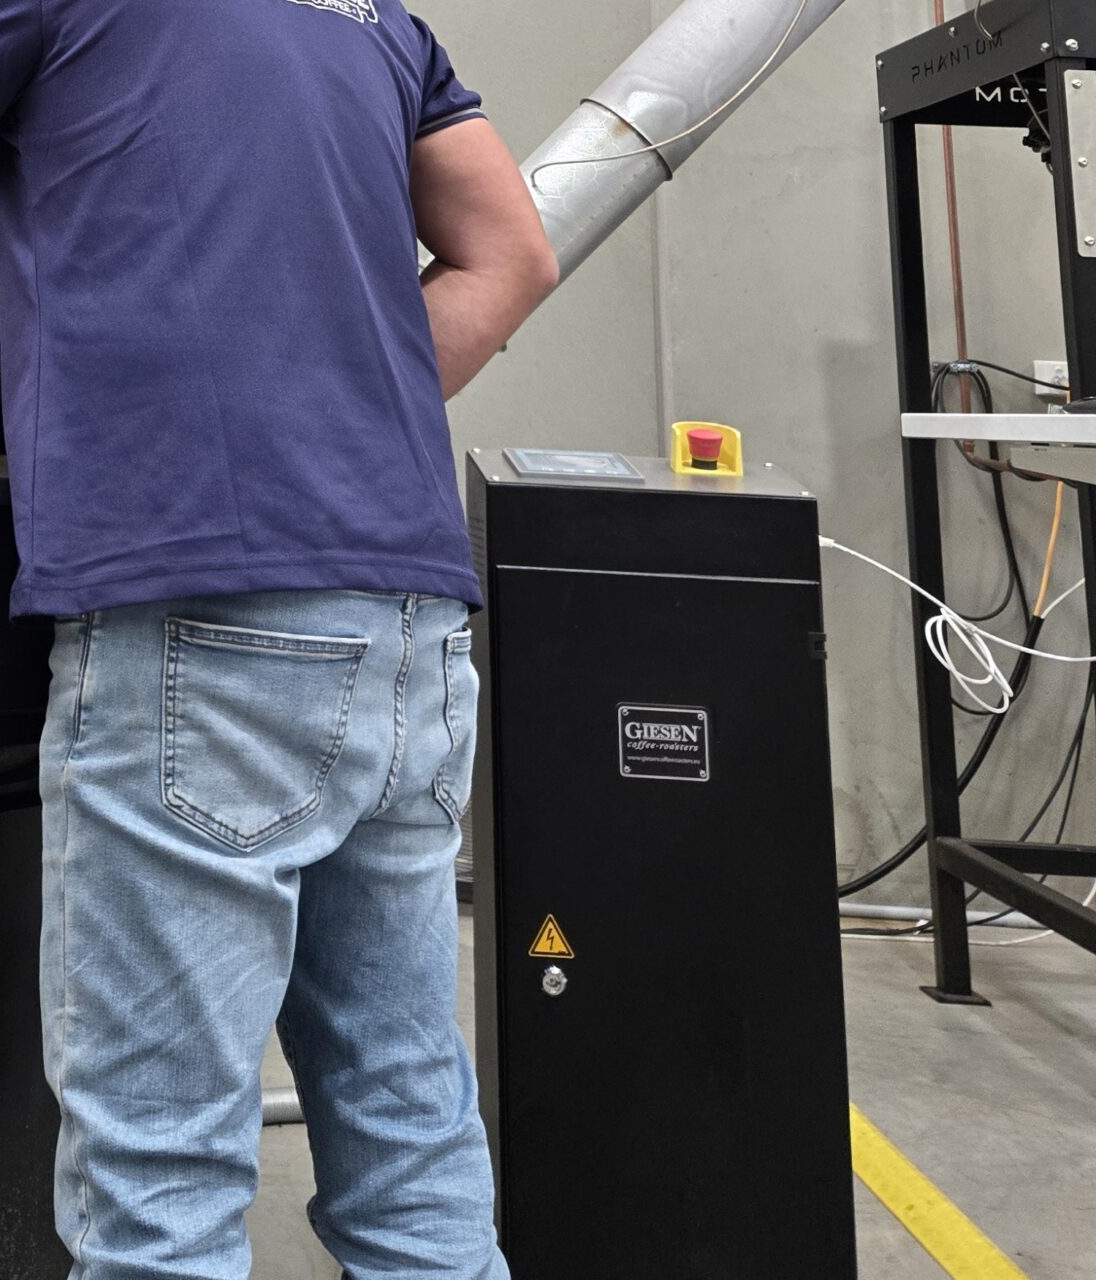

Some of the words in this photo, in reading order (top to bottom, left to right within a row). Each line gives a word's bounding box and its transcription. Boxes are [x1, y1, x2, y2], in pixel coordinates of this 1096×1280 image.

[911, 30, 1004, 82] PHANTOM
[624, 721, 701, 742] GIESEN
[626, 740, 699, 752] coffee-roasters
